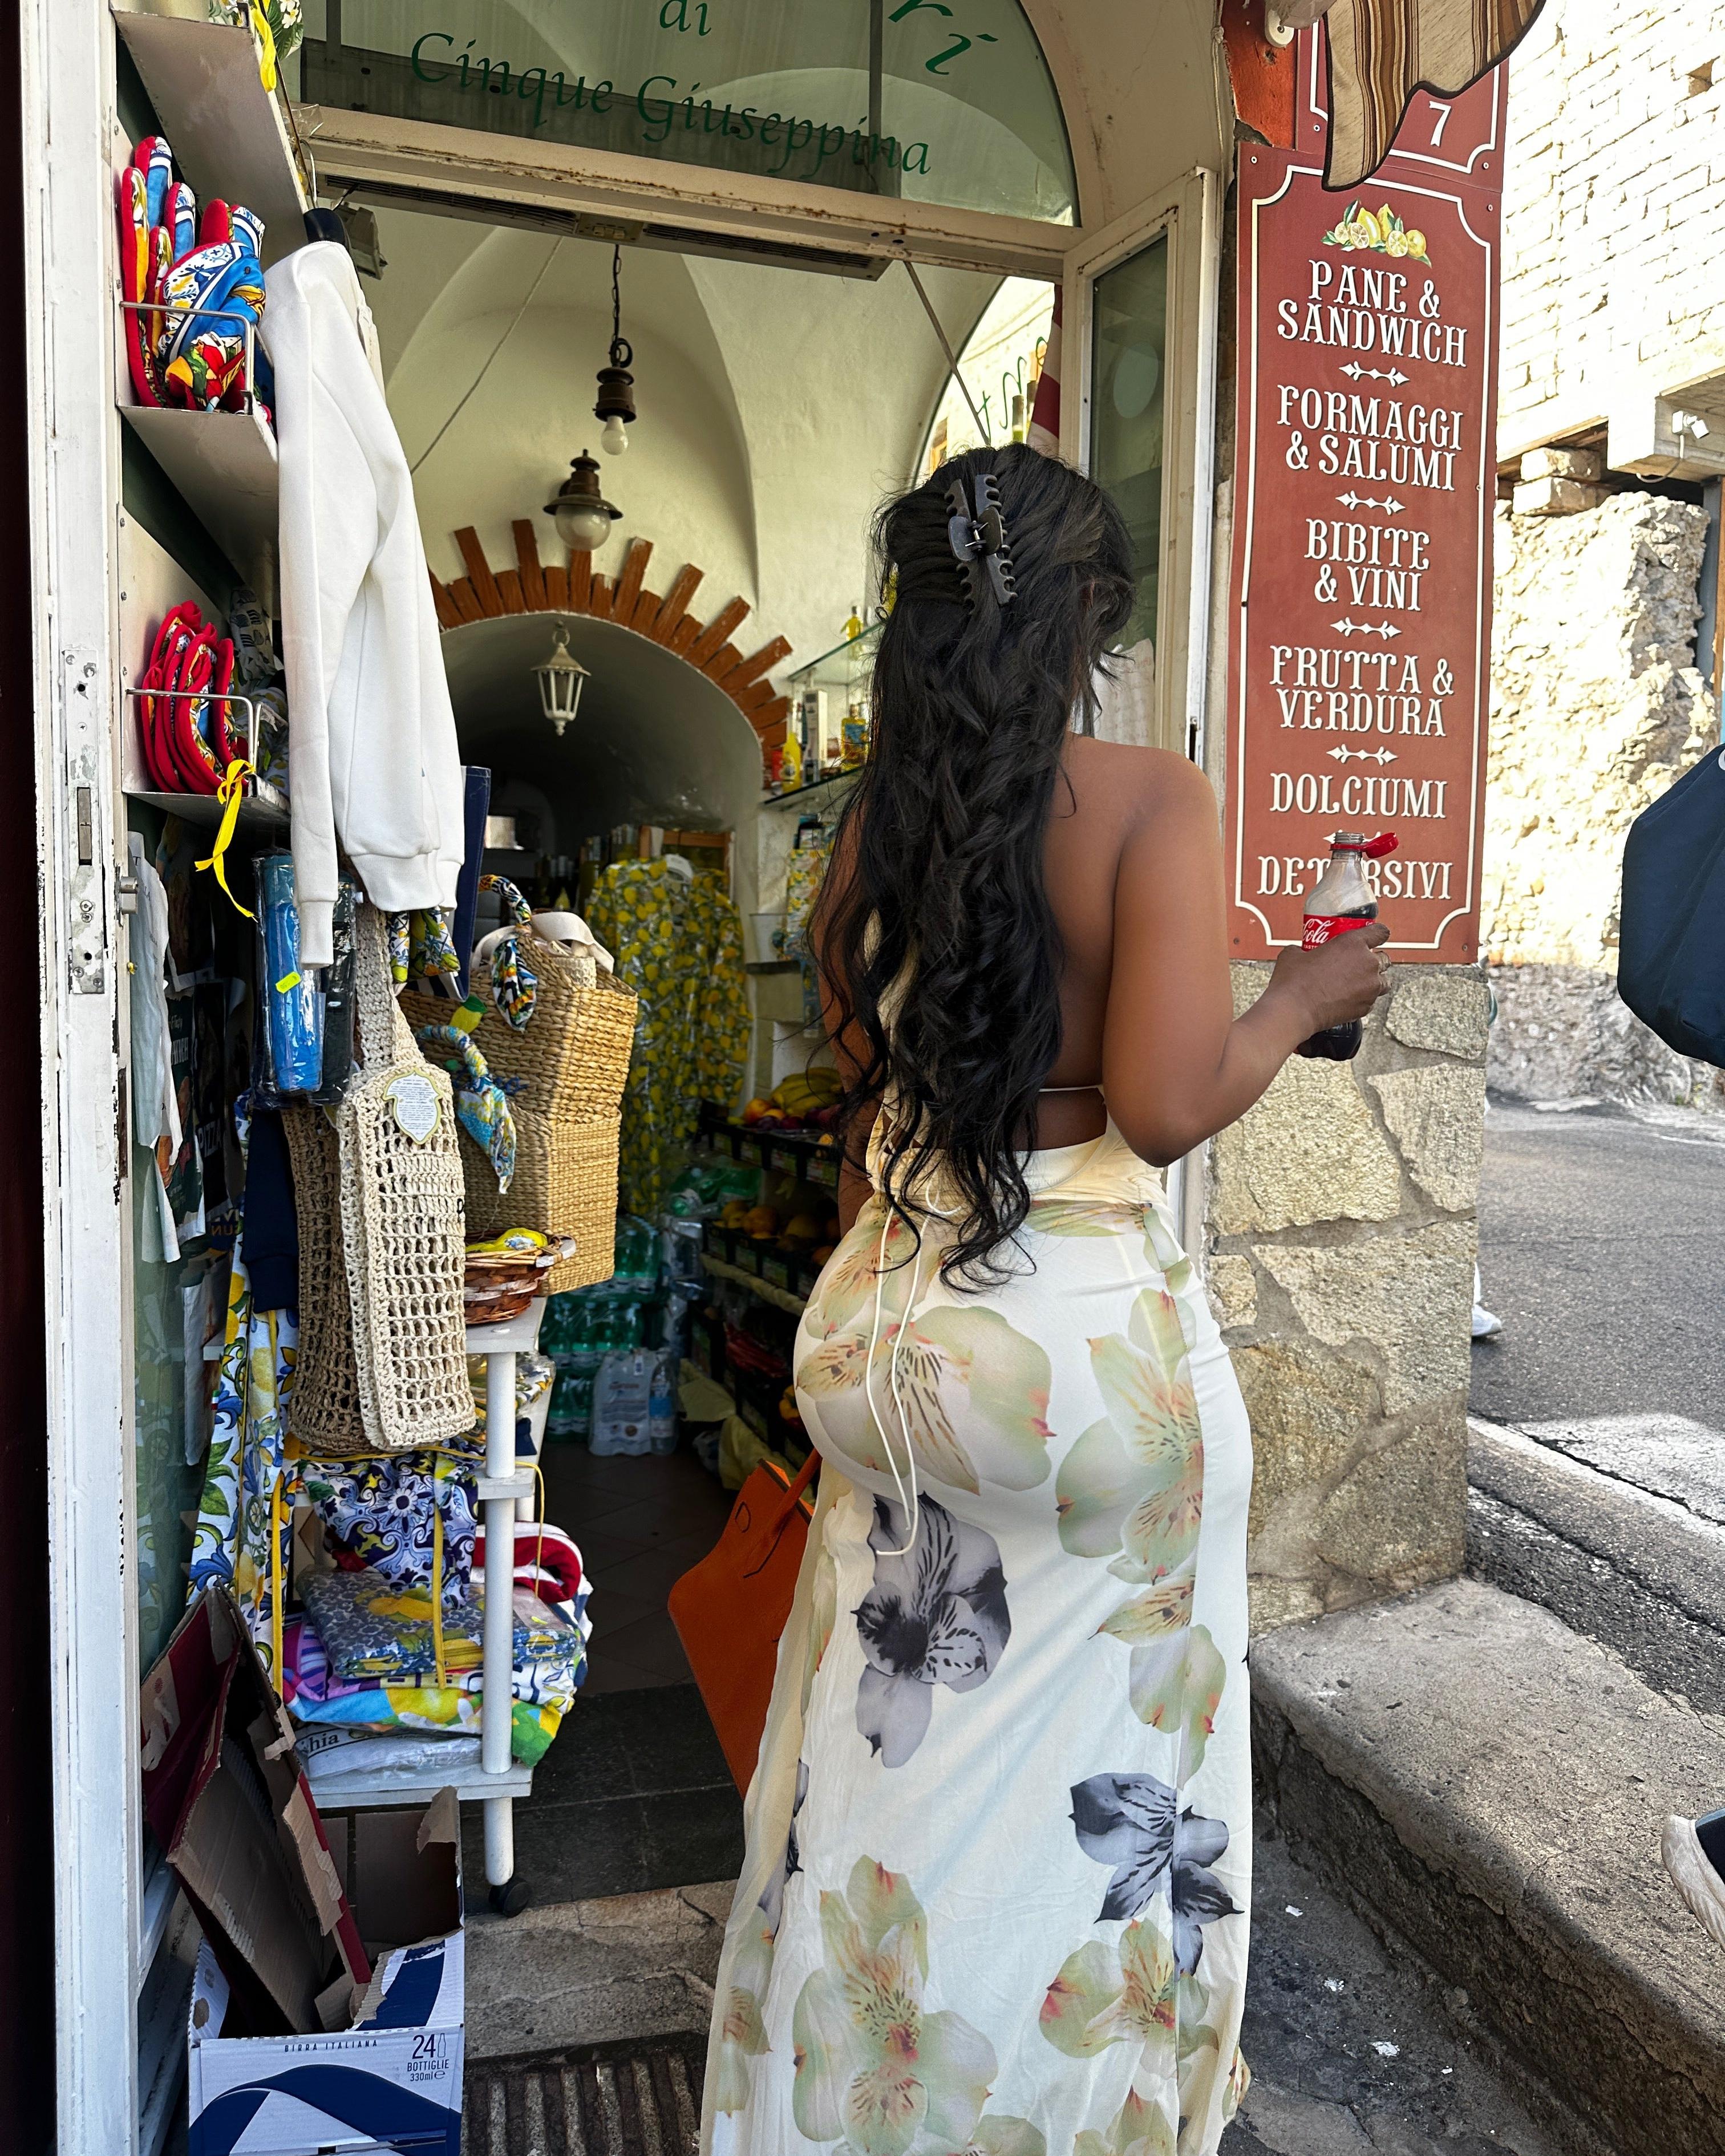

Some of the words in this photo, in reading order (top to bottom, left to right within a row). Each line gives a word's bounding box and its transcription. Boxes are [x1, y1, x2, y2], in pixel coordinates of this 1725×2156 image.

[411, 33, 613, 128] Cinque
[637, 75, 932, 179] Giuseppina
[1308, 259, 1407, 314] PANE
[1419, 279, 1441, 318] &
[1277, 299, 1468, 368] SANDWICH
[1277, 384, 1464, 451] FORMAGGI
[1285, 431, 1309, 469] &
[1319, 434, 1456, 491] SALUMI
[1304, 518, 1430, 570] BIBITE
[1314, 564, 1338, 603] &
[1347, 566, 1422, 611] VINI
[1269, 645, 1422, 694] FRUTTA
[1432, 658, 1454, 695] &
[1276, 688, 1446, 736] VERDURA
[1269, 773, 1448, 818] DOLCIUMI
[1257, 856, 1453, 899] DETRSIVI
[285, 2044, 318, 2052] BIRRA
[326, 2039, 377, 2050] ITALIANA
[407, 2059, 450, 2072] BOTTIGLIE
[411, 2033, 436, 2059] 24
